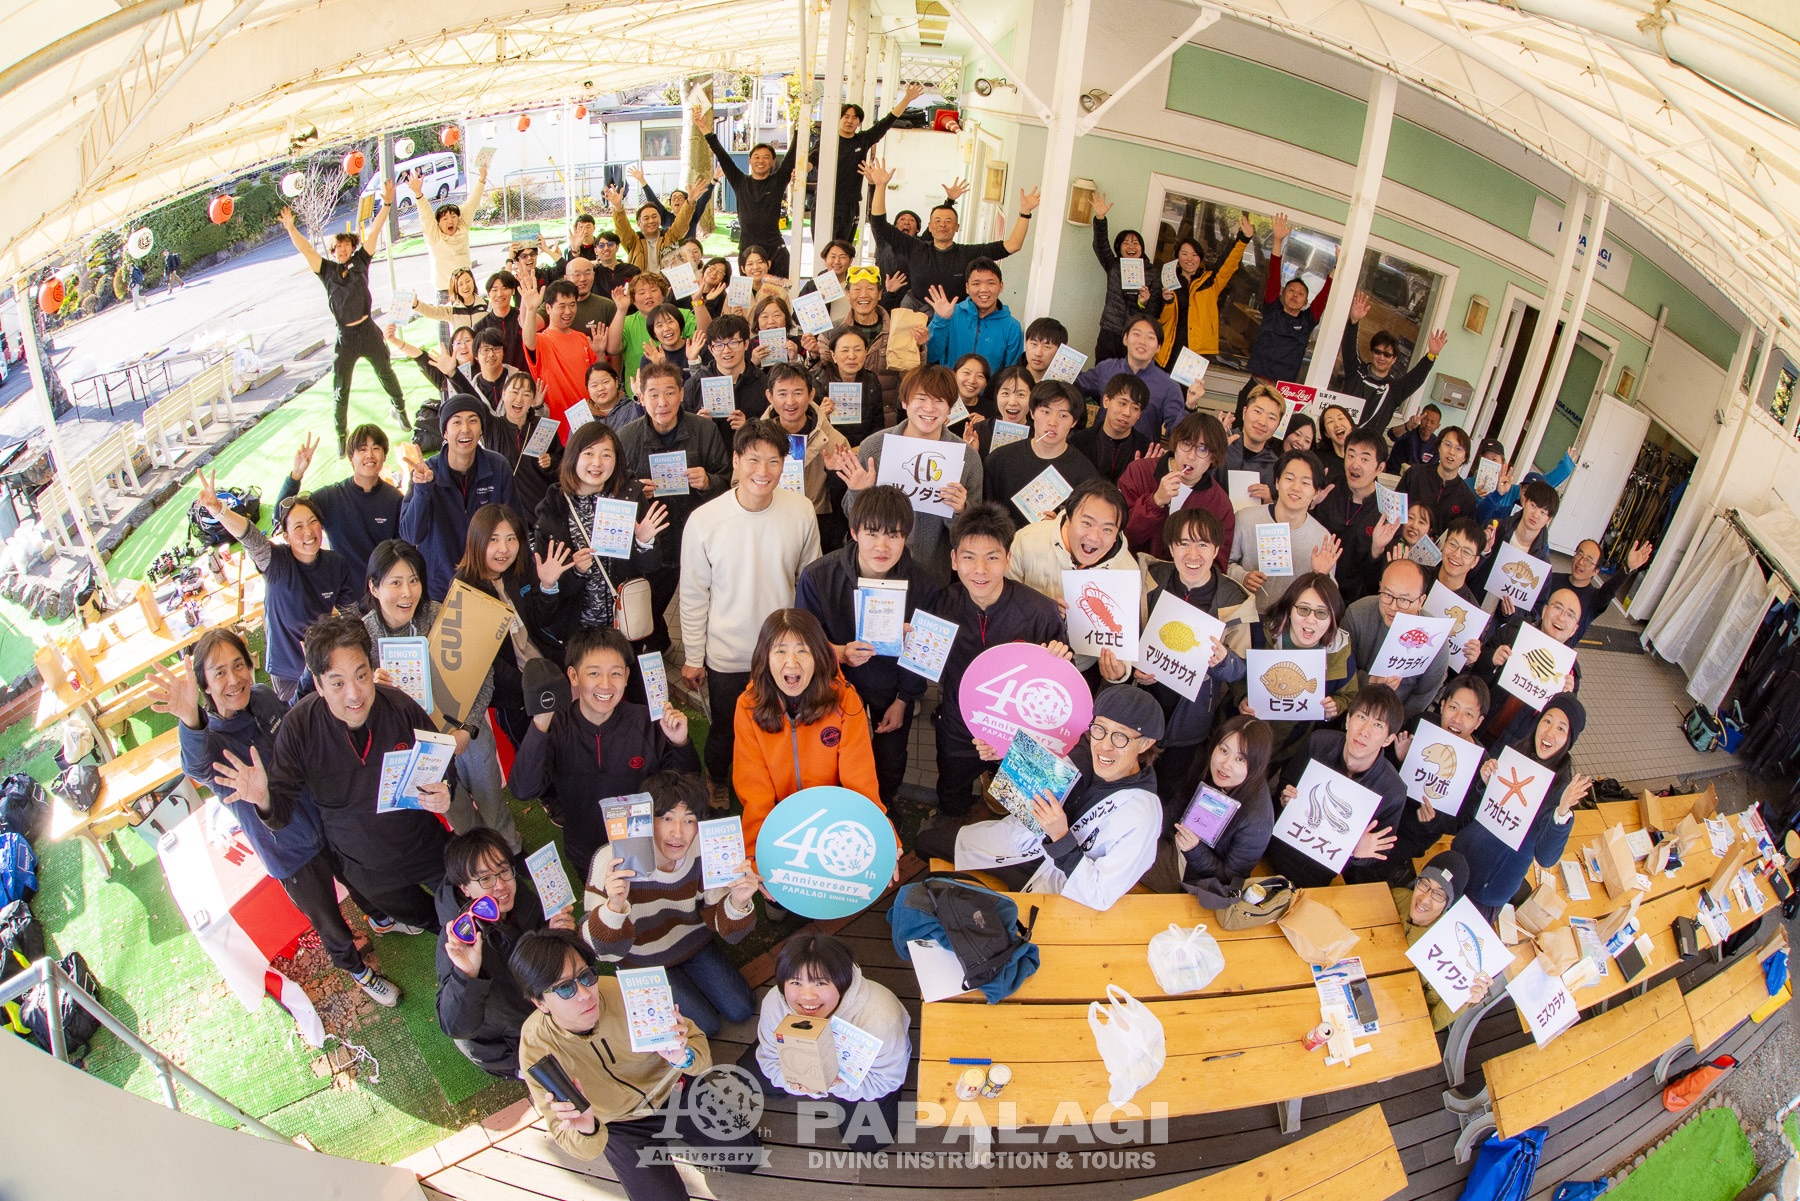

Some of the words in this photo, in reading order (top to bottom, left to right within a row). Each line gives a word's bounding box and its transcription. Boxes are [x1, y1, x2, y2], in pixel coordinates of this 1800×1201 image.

[601, 503, 632, 514] BINGYO
[1501, 584, 1529, 602] メバル
[441, 591, 463, 672] GULL
[495, 615, 512, 641] GULL
[917, 616, 950, 635] BINGYO
[1084, 629, 1124, 648] イセエビ
[388, 650, 418, 659] BINGYO
[1388, 655, 1429, 671] サクラダイ
[1146, 644, 1197, 687] マツカサウオ
[1512, 673, 1554, 702] カゴカキダイ
[975, 663, 1073, 730] 40
[1059, 726, 1071, 738] th
[1269, 698, 1308, 713] ヒラメ
[981, 727, 1013, 742] PAPALA
[982, 715, 1054, 747] Annivary
[389, 756, 409, 766] BING
[1007, 758, 1018, 771] The
[1414, 768, 1451, 796] ウツボ
[1483, 797, 1522, 831] アカヒトデ
[705, 824, 737, 836] BINGYO
[773, 808, 876, 877] 40
[865, 870, 877, 880] th
[1287, 821, 1343, 861] ゴンズイ
[531, 850, 554, 871] BINGYO
[782, 872, 859, 894] Anniversary
[782, 885, 827, 899] PAPALAGI
[829, 894, 846, 902] SINCE
[1427, 943, 1469, 991] マイワシ
[625, 975, 661, 987] BINGYO
[1536, 989, 1566, 1028] ミズクラゲ
[836, 1023, 874, 1048] BINGYO
